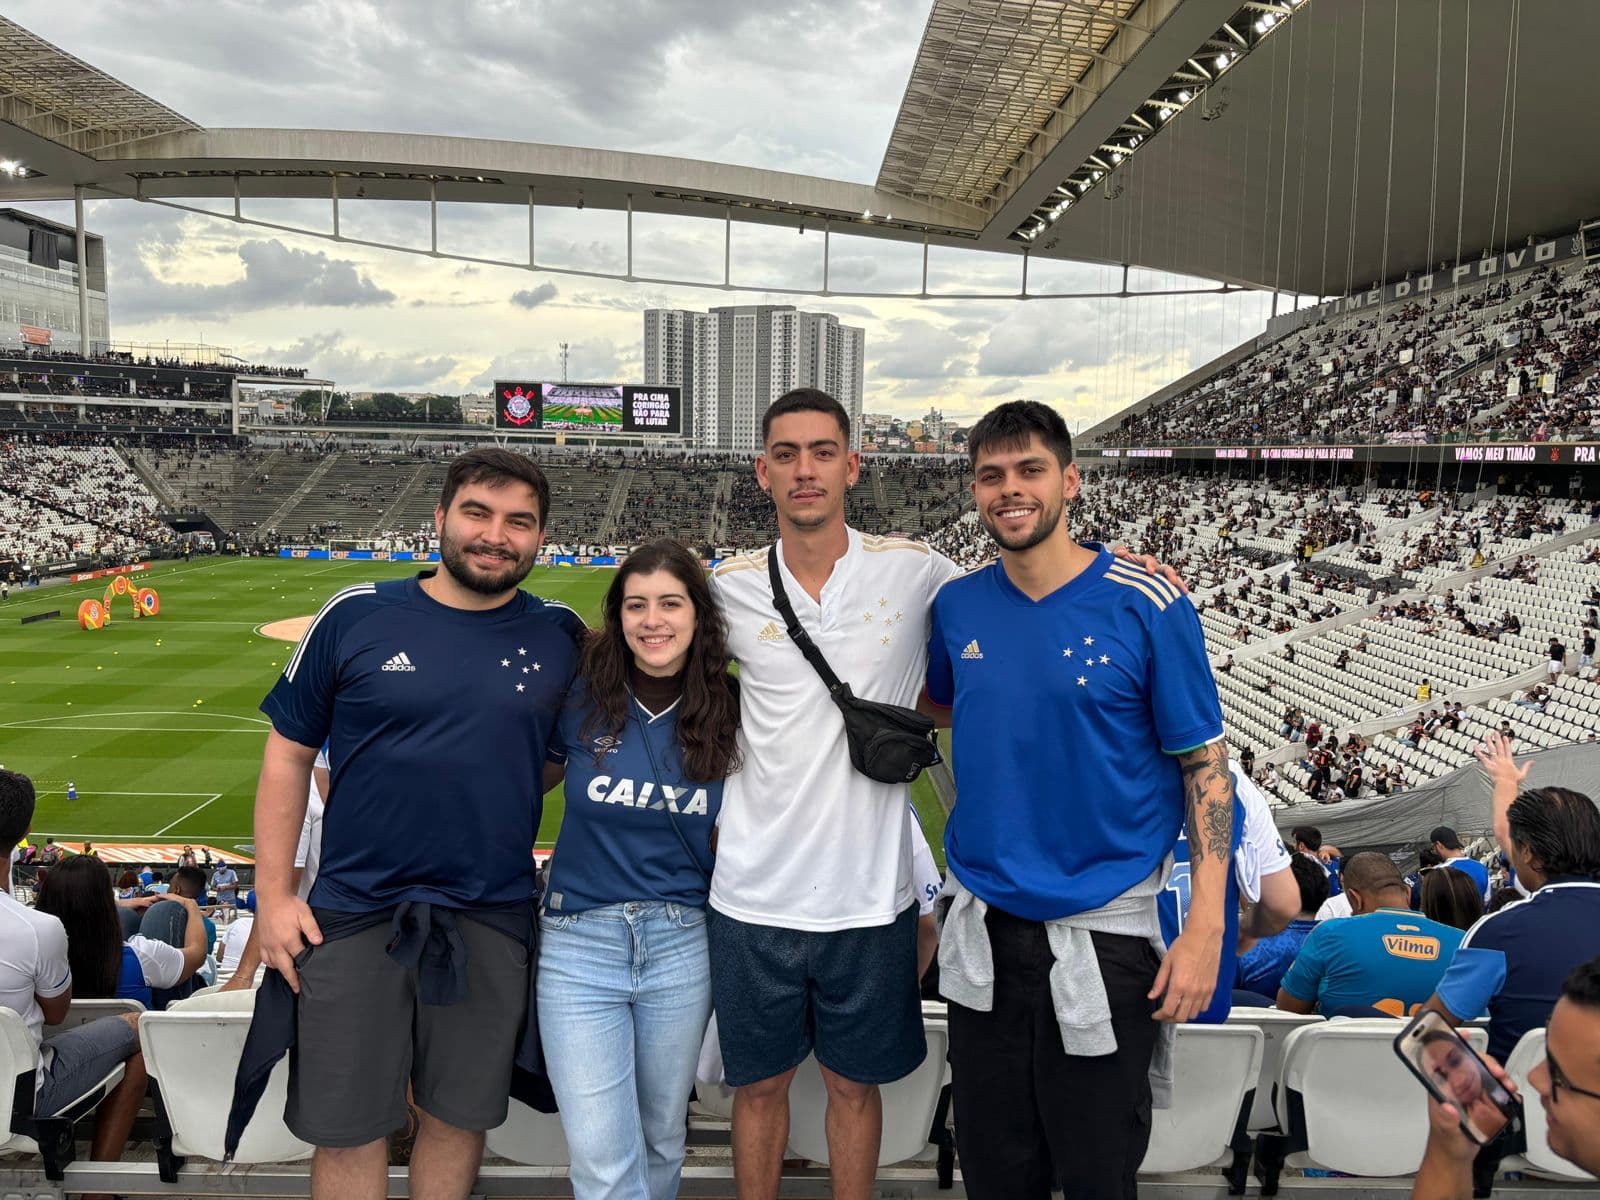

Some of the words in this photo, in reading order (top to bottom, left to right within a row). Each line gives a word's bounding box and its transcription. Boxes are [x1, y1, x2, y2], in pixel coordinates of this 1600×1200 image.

[1319, 289, 1380, 316] TIME
[1395, 274, 1434, 298] DO
[1452, 241, 1556, 283] POVO
[633, 393, 649, 401] PRA
[650, 393, 669, 402] CIMA
[632, 401, 670, 409] CORINGÃO
[633, 408, 649, 417] NÃO
[650, 409, 670, 418] PARA
[635, 417, 645, 425] DE
[646, 417, 668, 426] LUTAR
[1455, 447, 1484, 461] VAMOS
[1485, 447, 1505, 461] MEU
[1506, 445, 1536, 461] TIMÃO
[1574, 446, 1596, 462] PRA
[291, 549, 309, 558] CBF
[331, 551, 349, 559] CBF
[411, 552, 430, 560] CBF
[574, 556, 593, 564] CBF
[757, 633, 785, 641] adidas
[960, 652, 983, 660] adidas
[587, 775, 708, 815] CAIXA
[1386, 937, 1435, 955] Vilma
